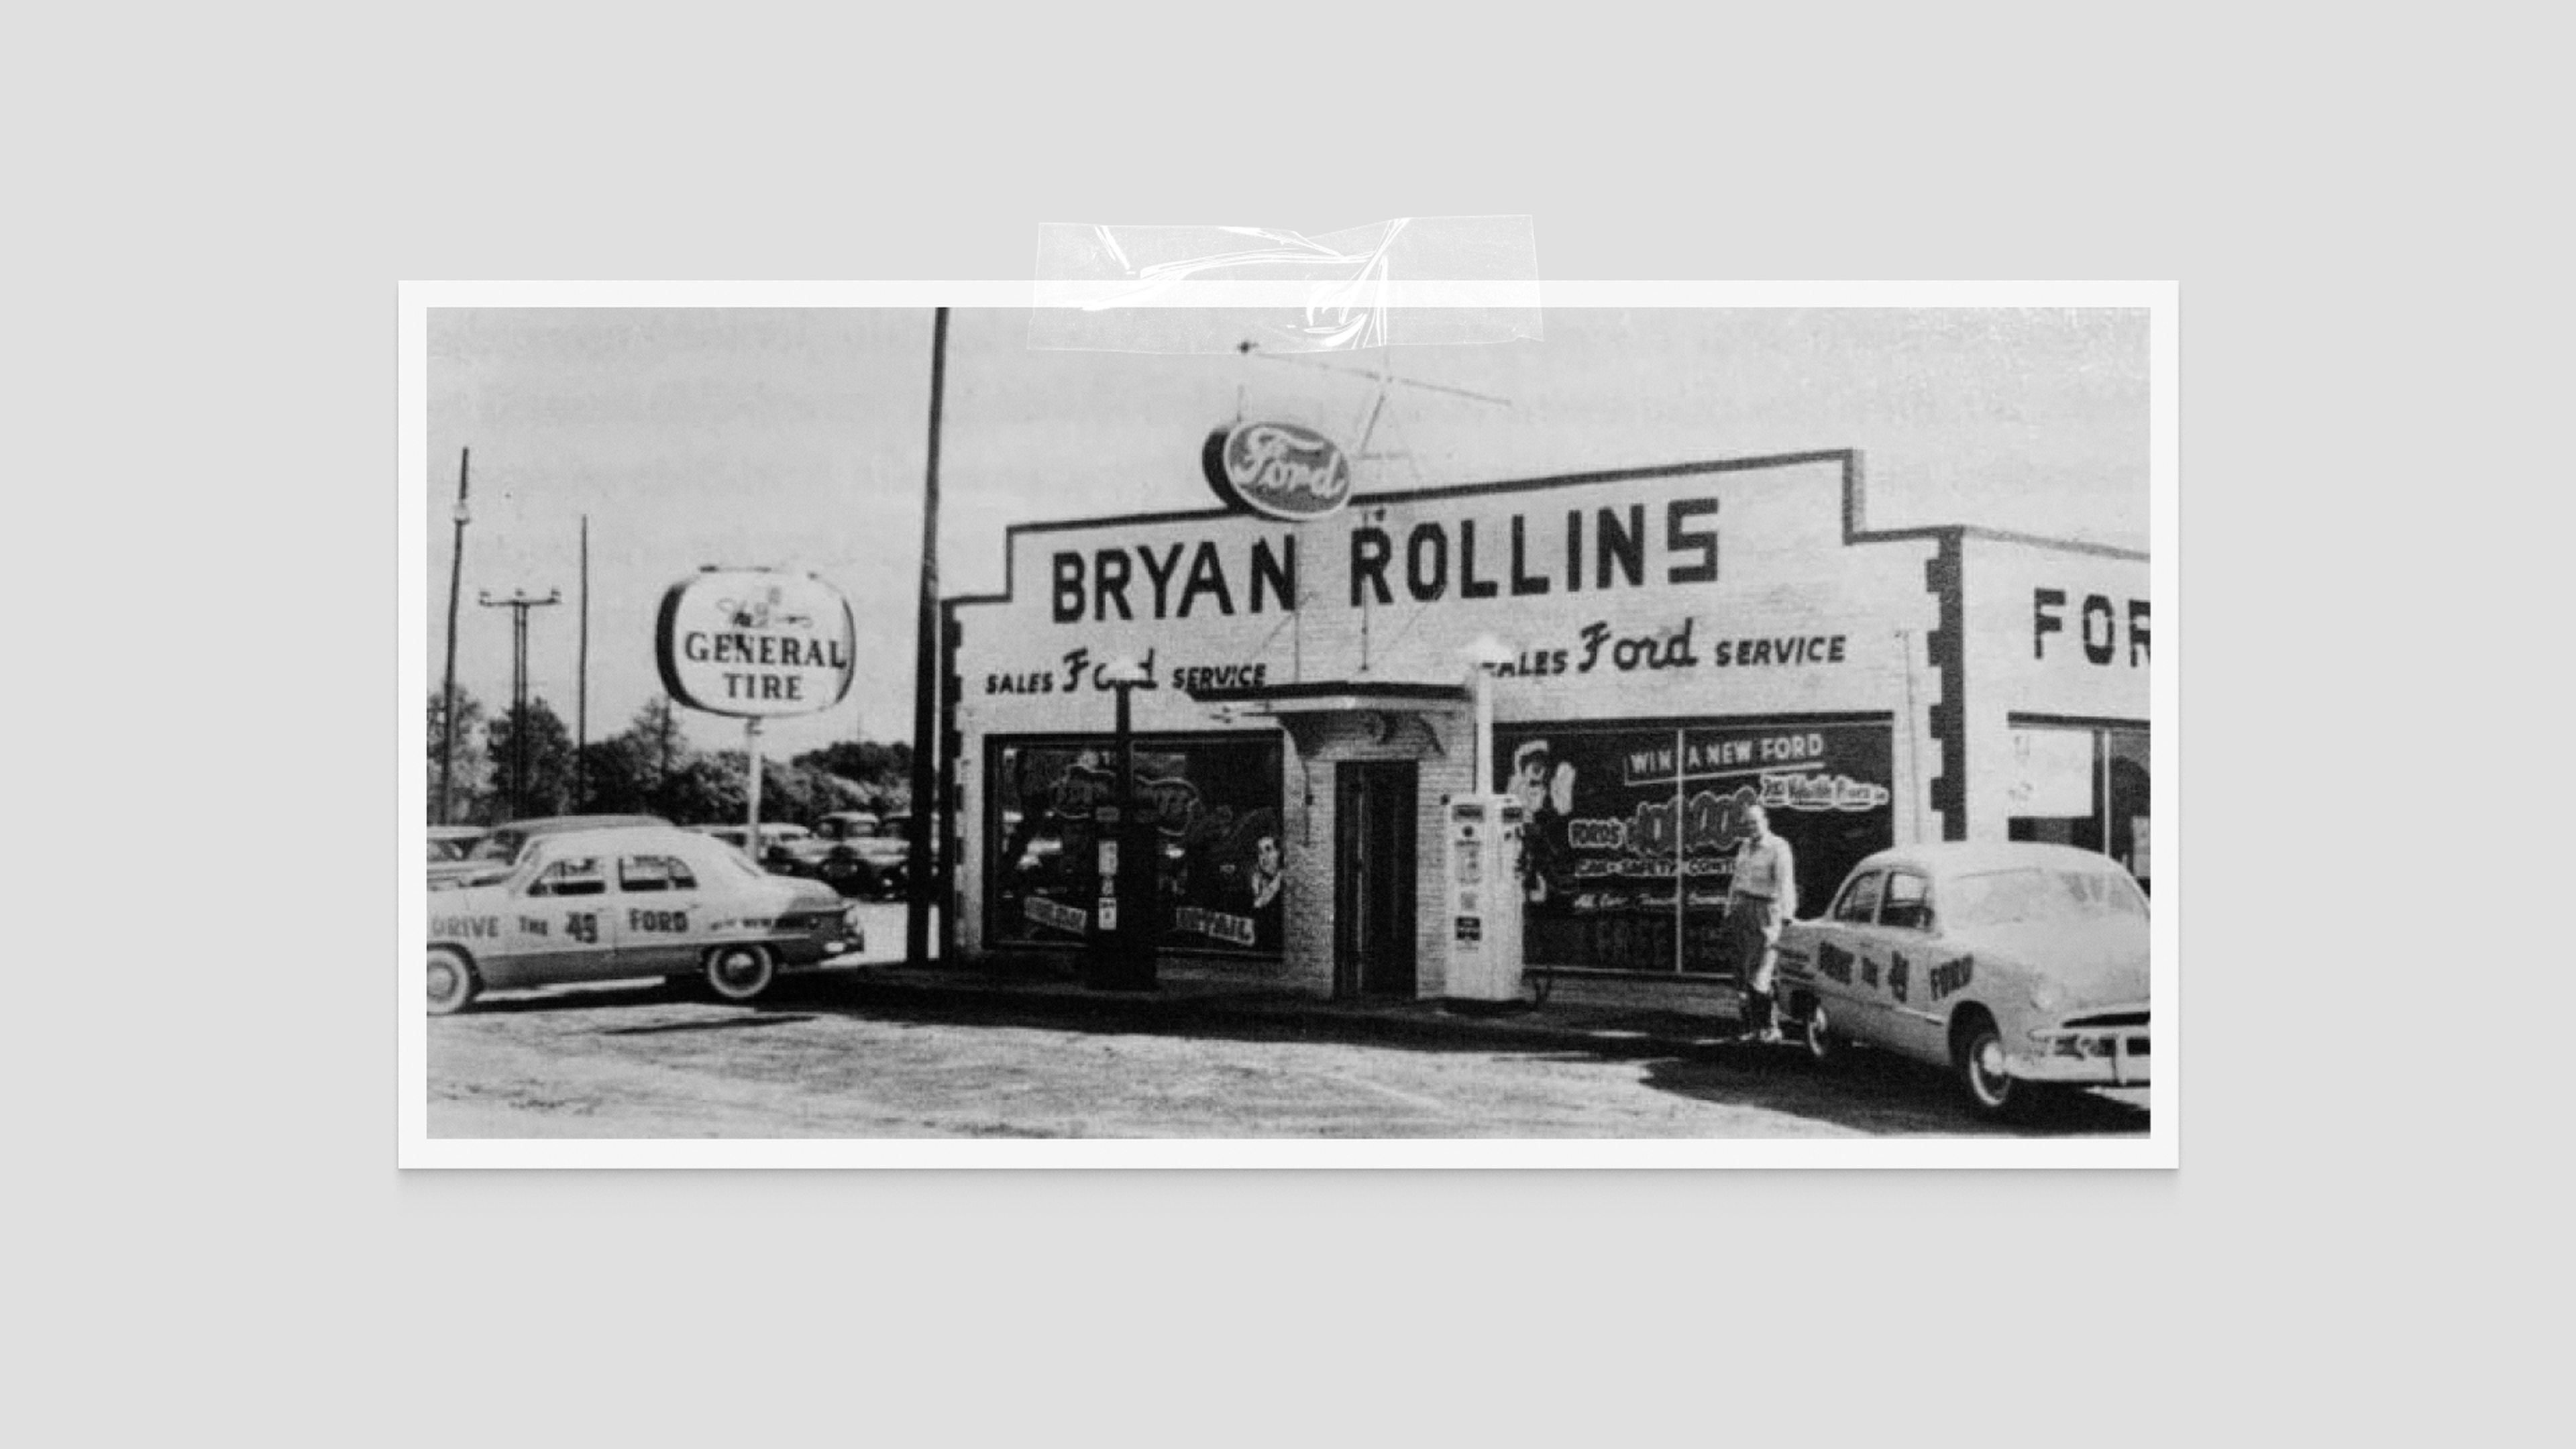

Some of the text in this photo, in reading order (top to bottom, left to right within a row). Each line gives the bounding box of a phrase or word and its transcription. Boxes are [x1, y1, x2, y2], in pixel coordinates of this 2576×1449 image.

[1233, 428, 1344, 498] Ford
[1053, 498, 1719, 623] BRYAN ROLLINS
[685, 631, 847, 669] GENERAL
[1578, 617, 1699, 672] Ford
[1716, 635, 1846, 666] SERVICE
[722, 673, 804, 700] TIRE
[985, 672, 1053, 694] SALES
[1172, 662, 1267, 690] SERVICE
[1631, 733, 1824, 773] WIN A NEW FORD
[431, 916, 498, 937] DRIVE
[629, 908, 689, 933] FORD
